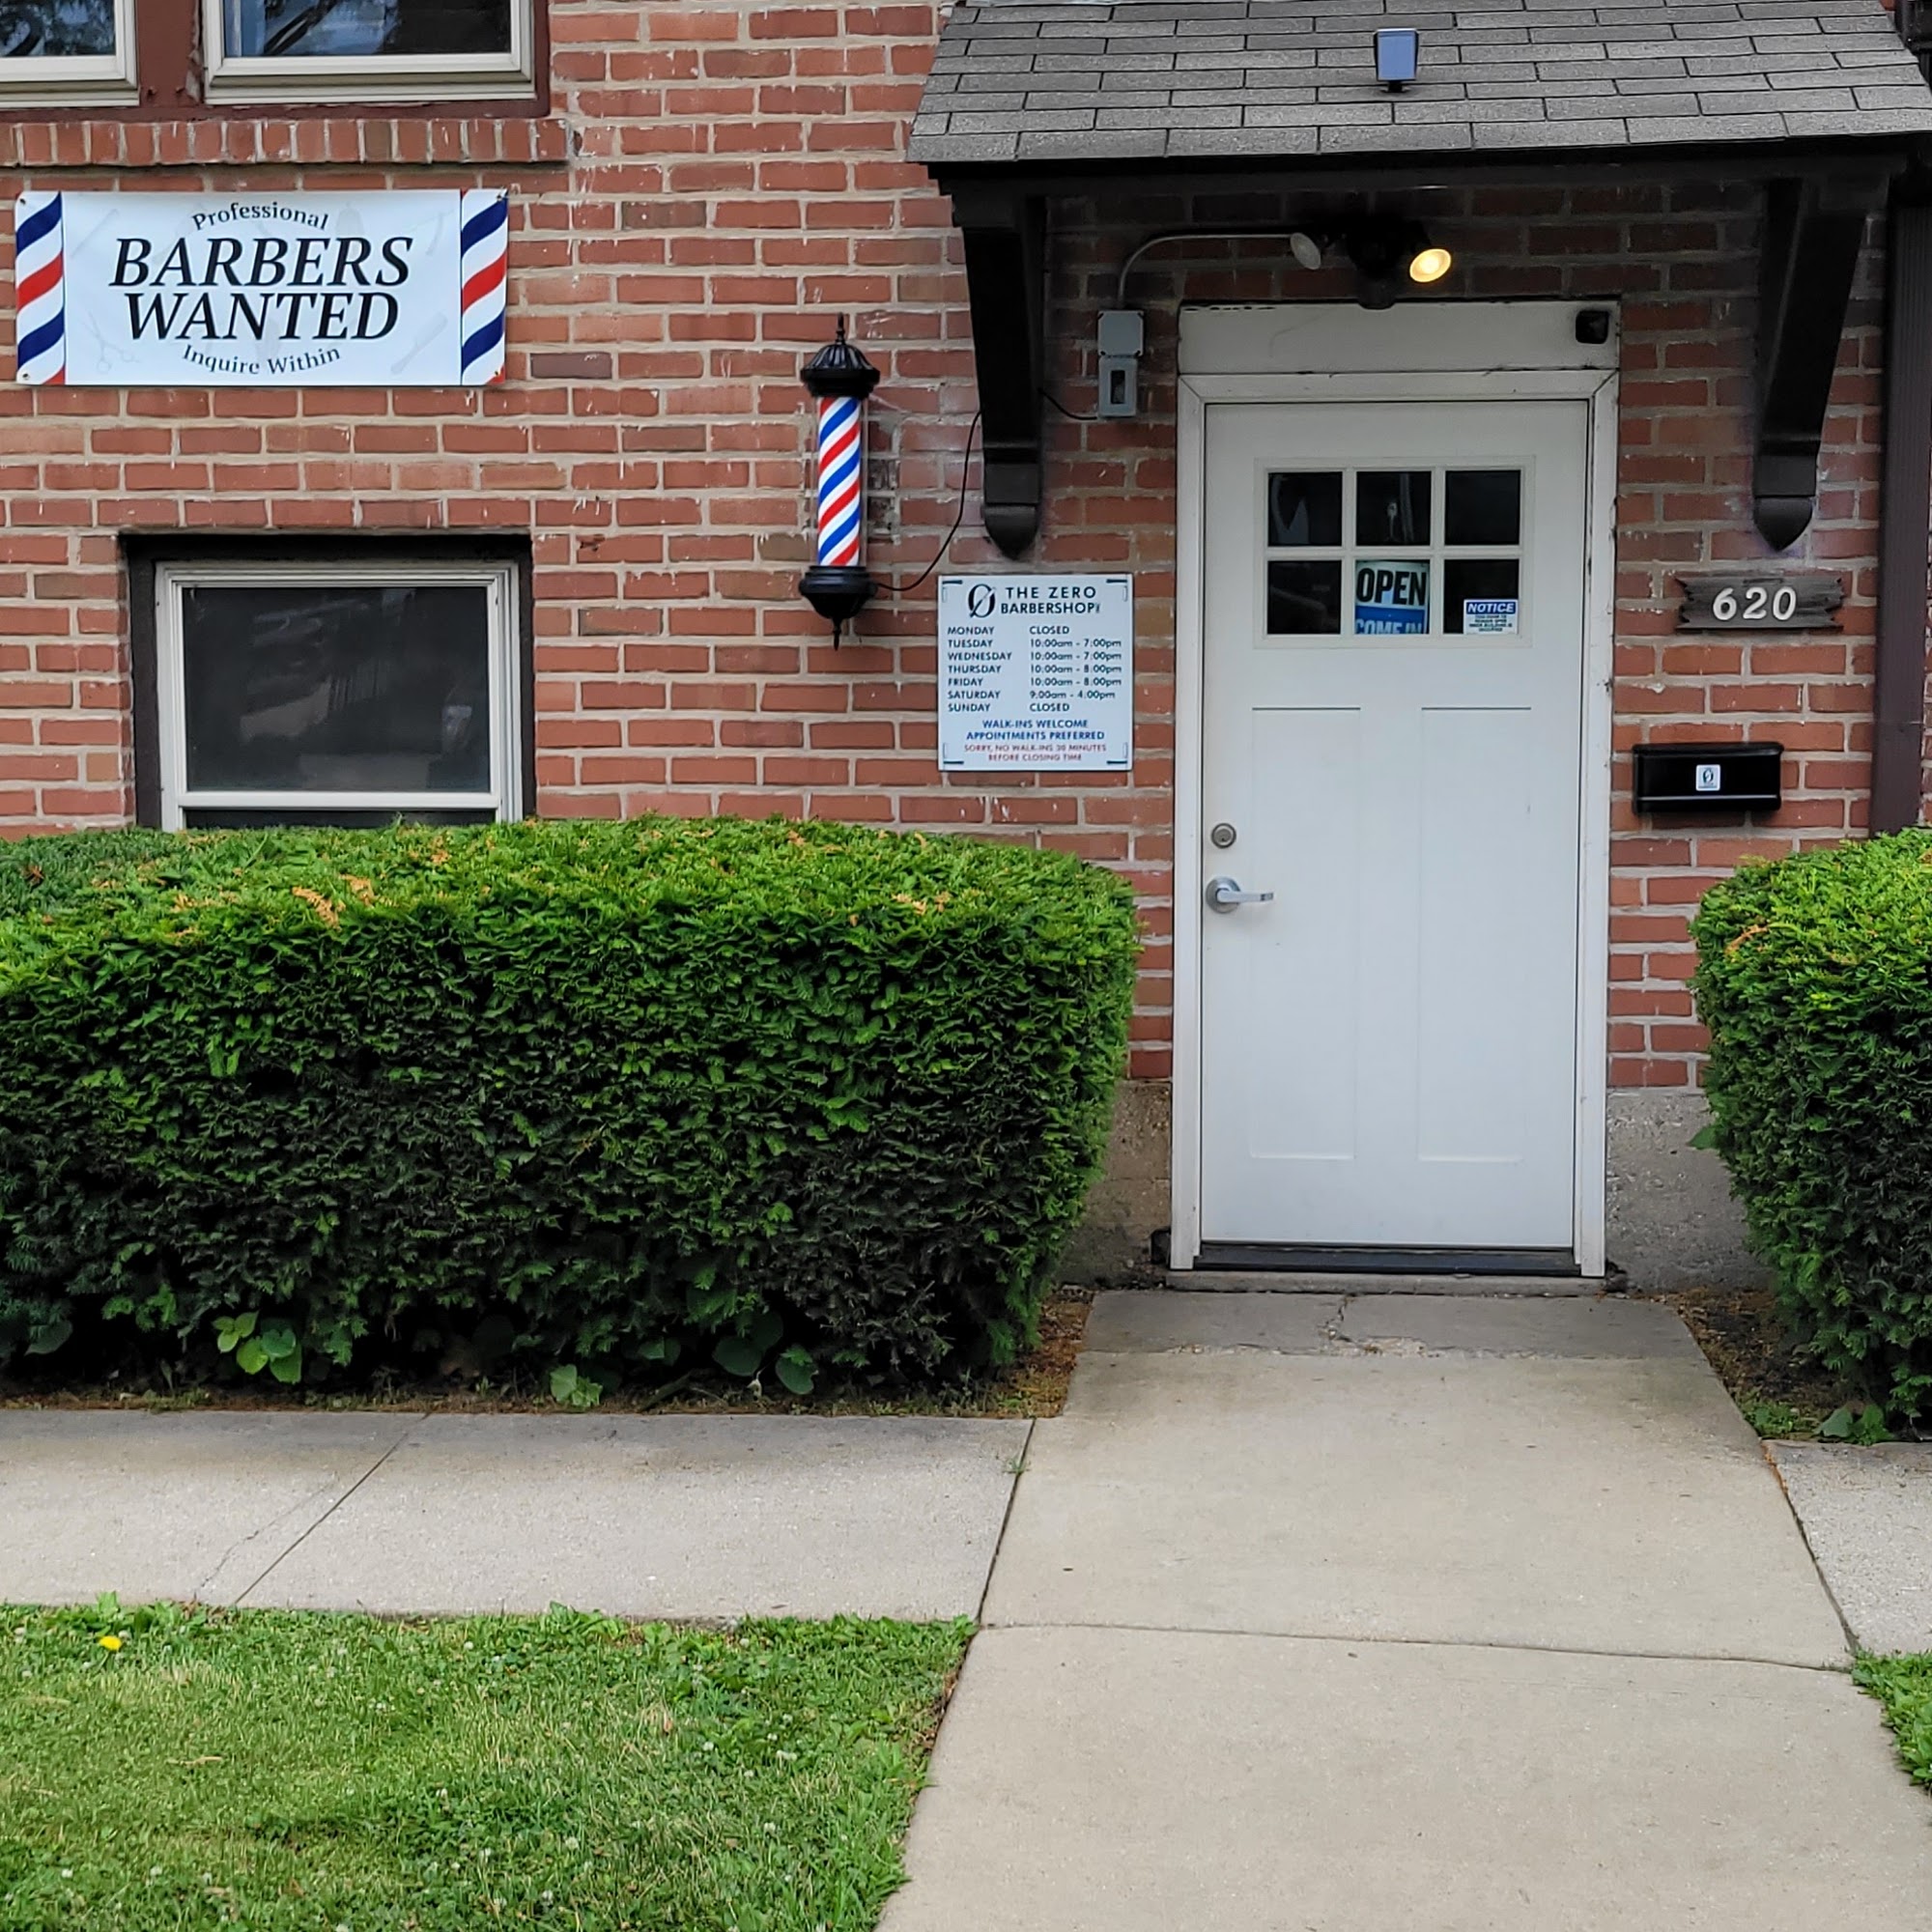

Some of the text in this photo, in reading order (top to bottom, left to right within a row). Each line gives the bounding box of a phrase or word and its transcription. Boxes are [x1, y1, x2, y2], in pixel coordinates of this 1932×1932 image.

[191, 201, 329, 232] Professional
[108, 236, 414, 287] BARBERS
[125, 292, 400, 341] WANTED
[182, 344, 341, 376] Inquire Within
[1355, 567, 1427, 607] OPEN
[1006, 585, 1096, 600] THE ZERO
[1467, 603, 1515, 613] NOTICE
[1712, 586, 1797, 621] 620
[948, 626, 1069, 635] MONDAY CLOSED
[948, 639, 993, 648] TUESDAY
[948, 652, 1012, 661] WEDNESDAY
[948, 665, 1002, 673] THURSDAY
[948, 677, 983, 686] FRIDAY
[948, 691, 1001, 699] SATURDAY
[948, 703, 1069, 712] SUNDAY CLOSED
[982, 720, 1088, 728] WALK-INS WELCOME
[966, 731, 1105, 740] APPOINTMENTS PREFERRED
